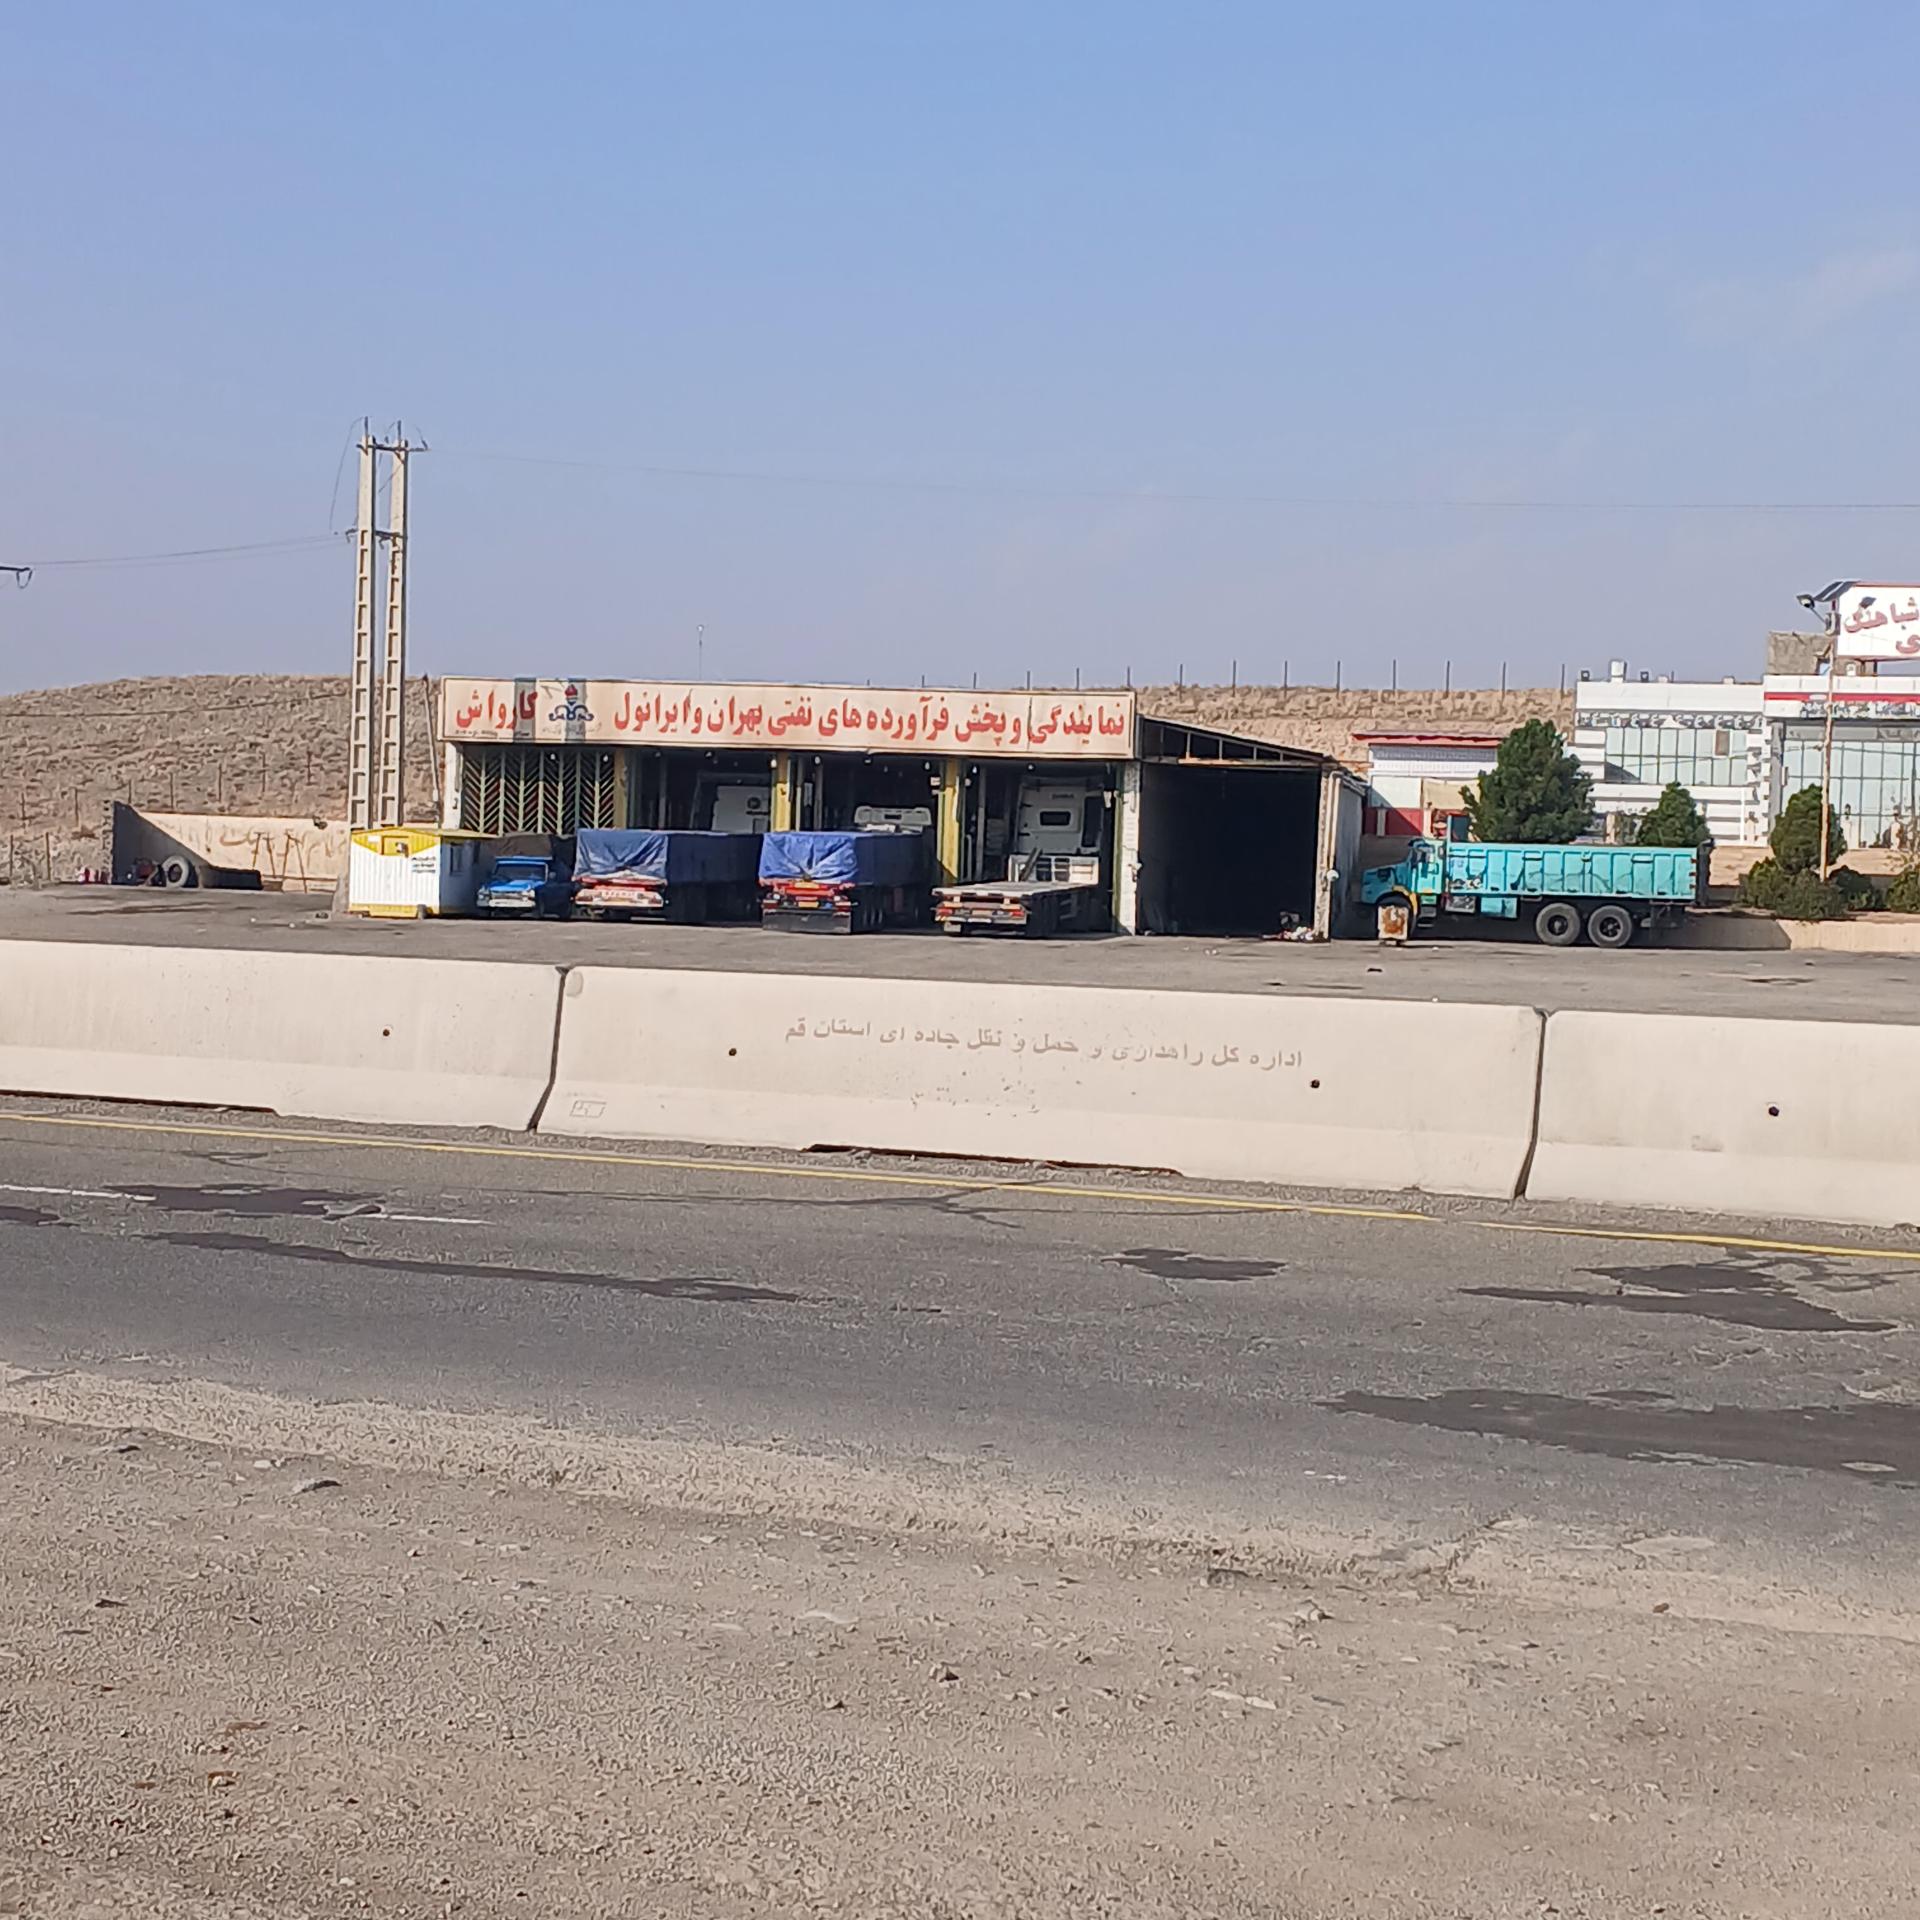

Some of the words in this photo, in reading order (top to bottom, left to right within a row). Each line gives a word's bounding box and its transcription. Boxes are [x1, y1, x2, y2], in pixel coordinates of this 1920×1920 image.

[455, 689, 538, 731] کارواش
[707, 696, 764, 738] بهران
[766, 696, 813, 738] نفتی
[818, 698, 863, 738] های
[954, 701, 1007, 747] پخش
[1010, 717, 1022, 745] و
[1027, 702, 1125, 746] نمایندگی
[785, 1016, 806, 1043] قم
[813, 1018, 872, 1039] استان
[879, 1026, 905, 1044] ای
[913, 1028, 961, 1050] جاده
[966, 1027, 1003, 1051] نقل
[1210, 1044, 1240, 1067] کل
[1248, 1050, 1304, 1072] اداره
